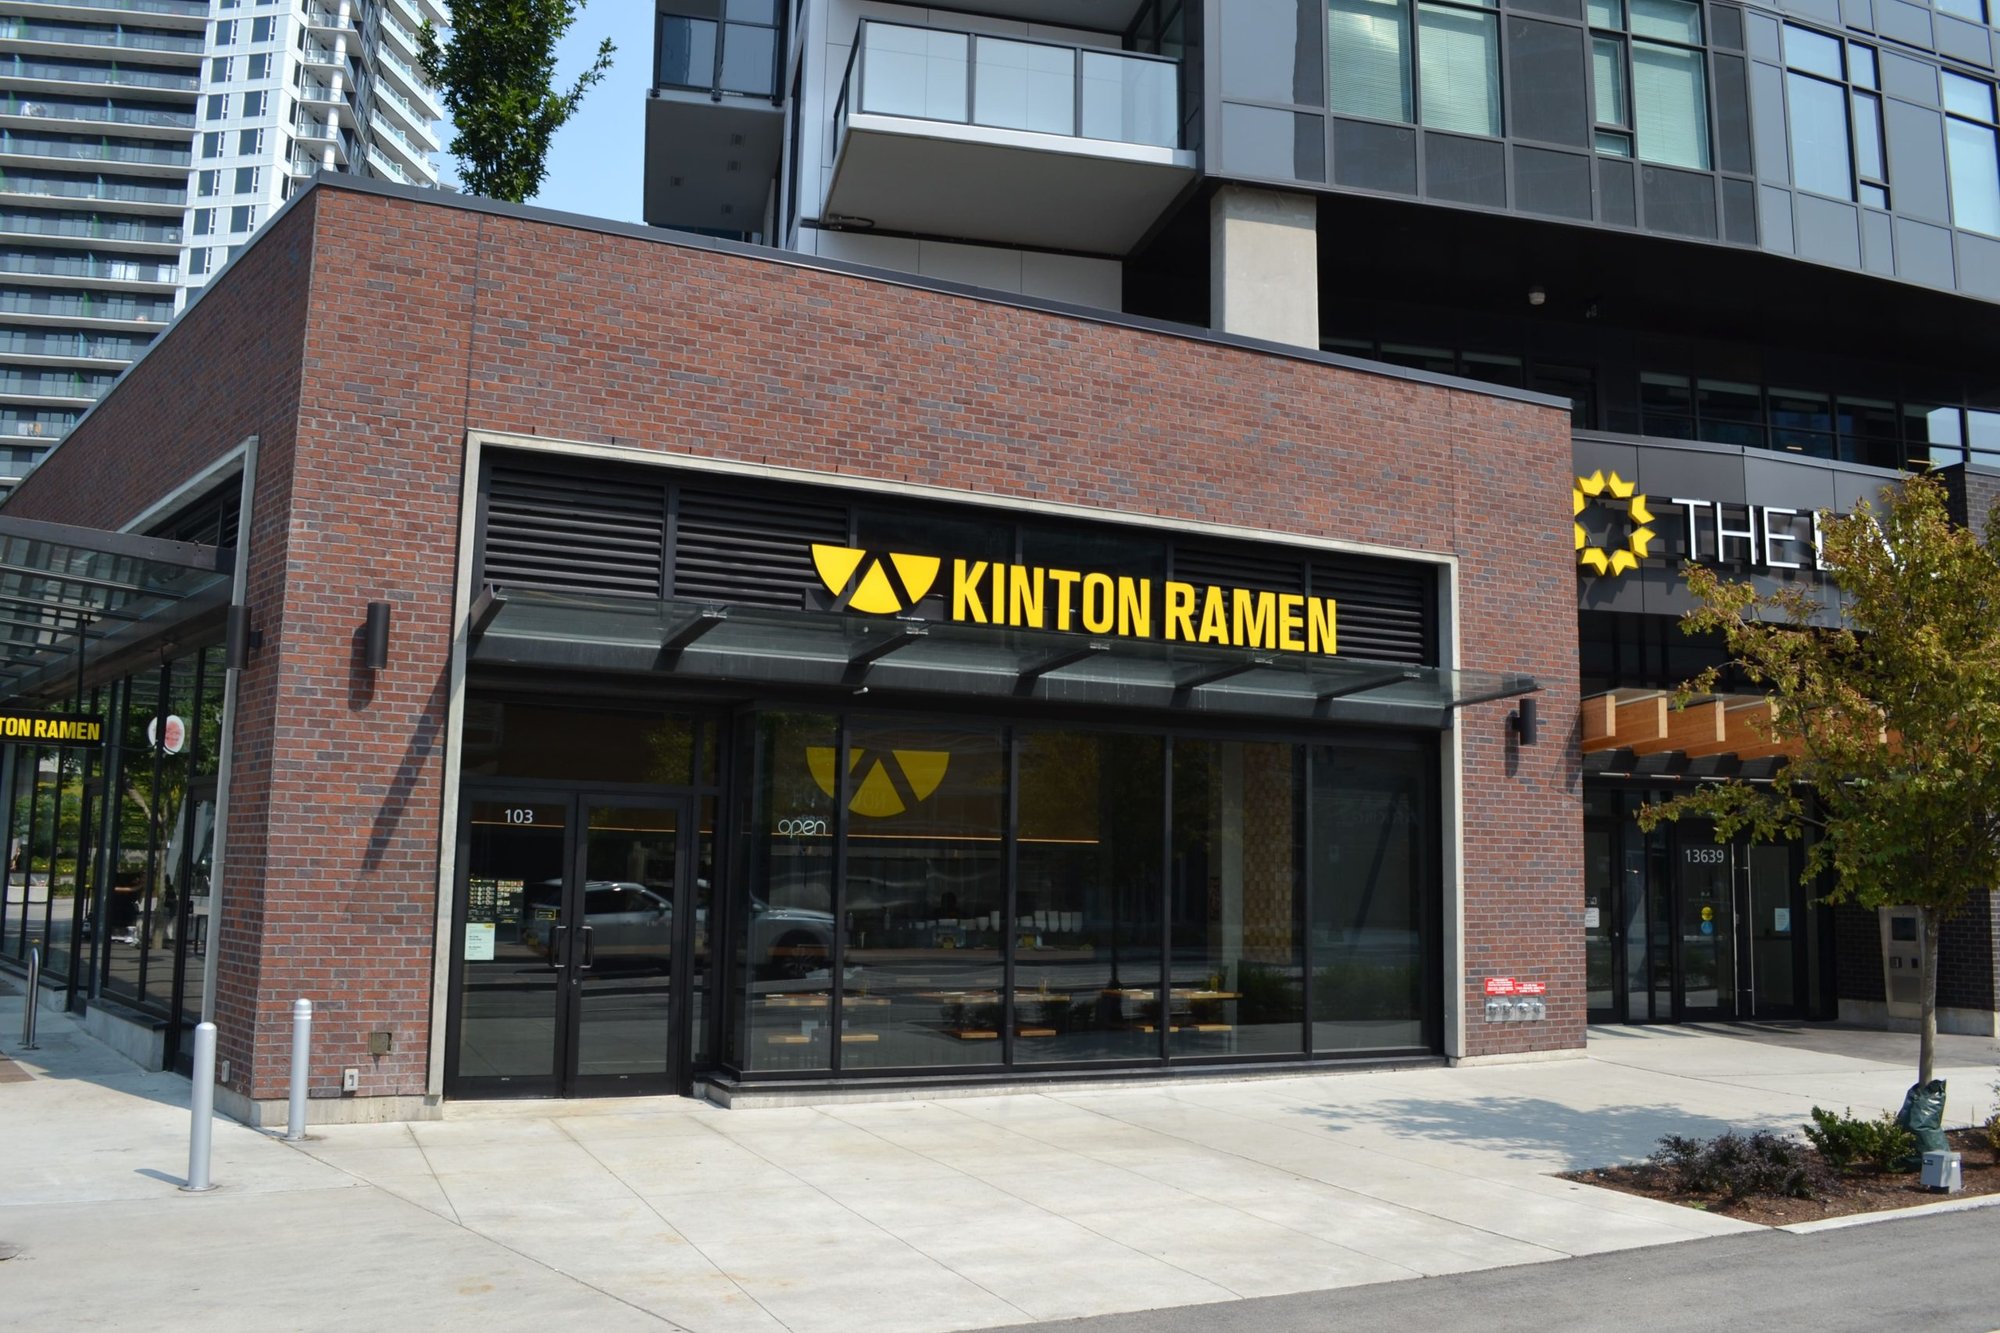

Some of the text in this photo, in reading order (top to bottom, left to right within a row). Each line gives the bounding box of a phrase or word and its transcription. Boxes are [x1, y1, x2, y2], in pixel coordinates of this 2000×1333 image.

[1671, 497, 1801, 570] THE
[952, 558, 1338, 655] KINTON RAMEN
[34, 719, 100, 741] RAMEN
[504, 808, 534, 824] 103
[778, 819, 826, 839] open
[1685, 848, 1725, 864] 13639
